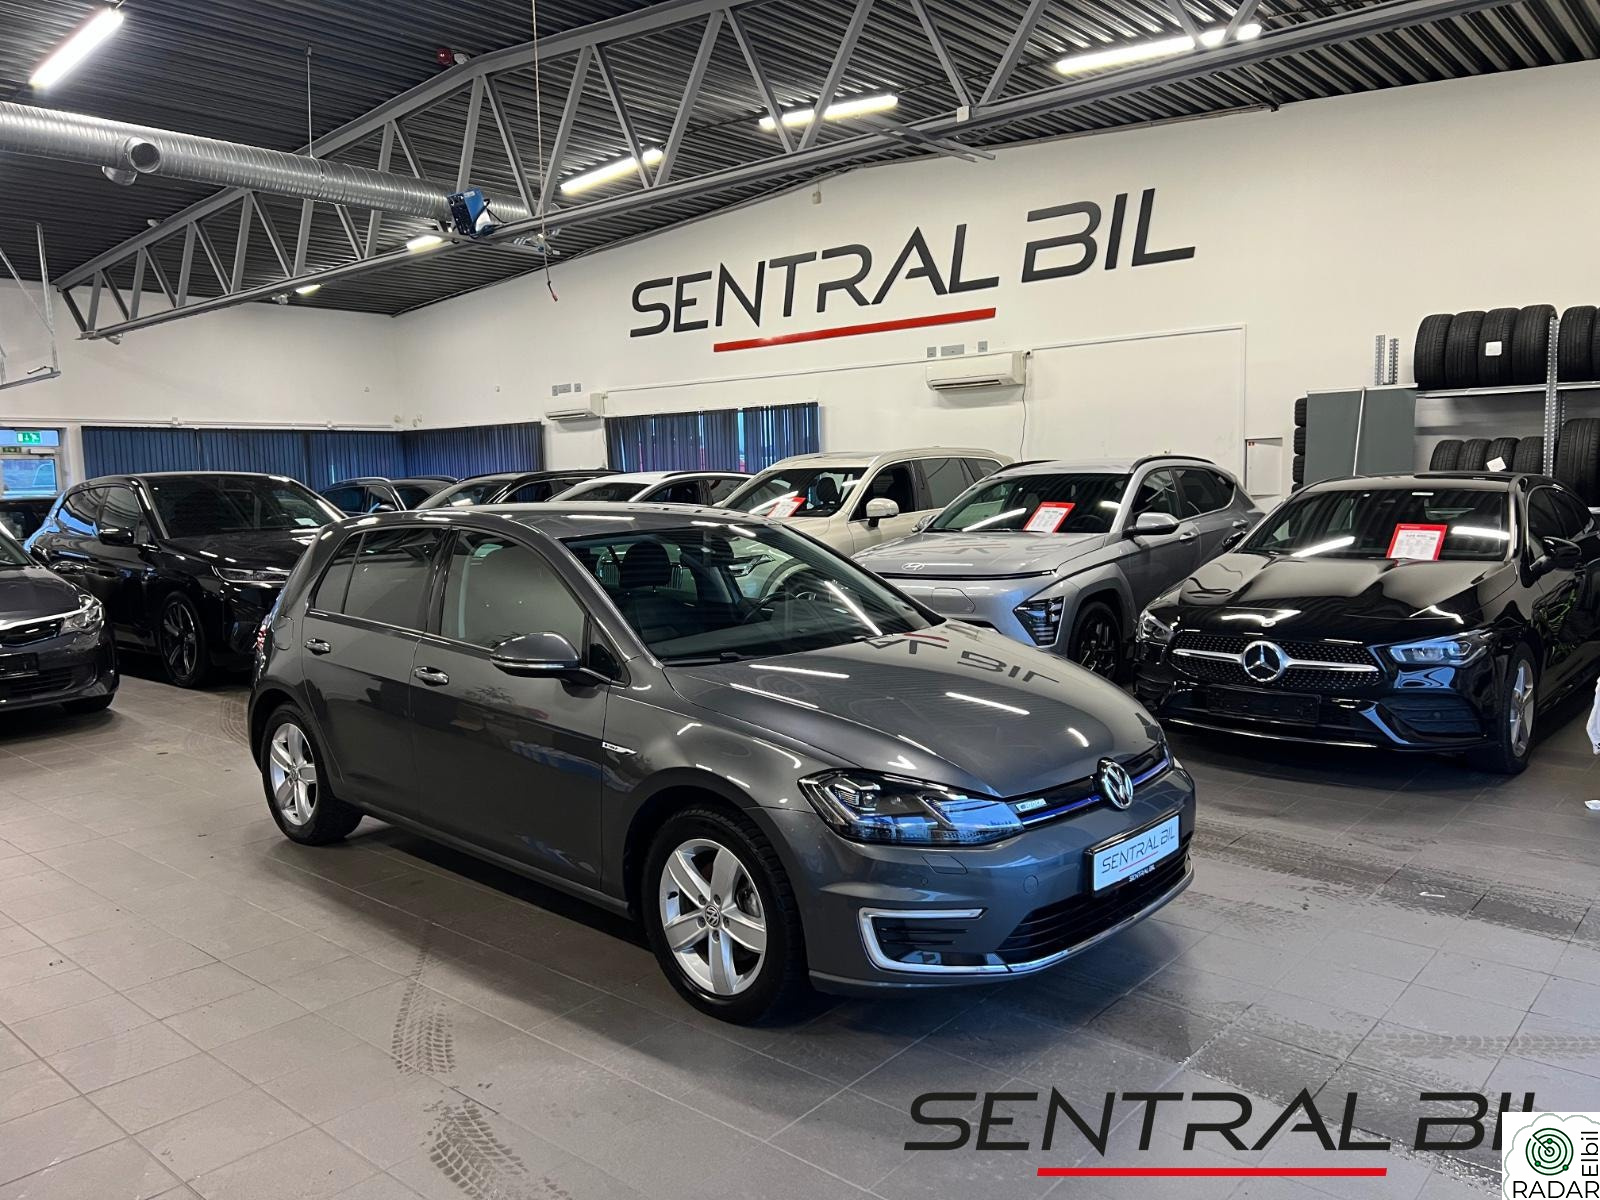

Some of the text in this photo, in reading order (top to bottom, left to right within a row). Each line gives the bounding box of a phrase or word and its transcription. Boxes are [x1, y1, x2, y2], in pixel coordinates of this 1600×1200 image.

[630, 187, 1196, 338] SENTRAL BIL
[1102, 826, 1175, 873] SENTRAL BIL
